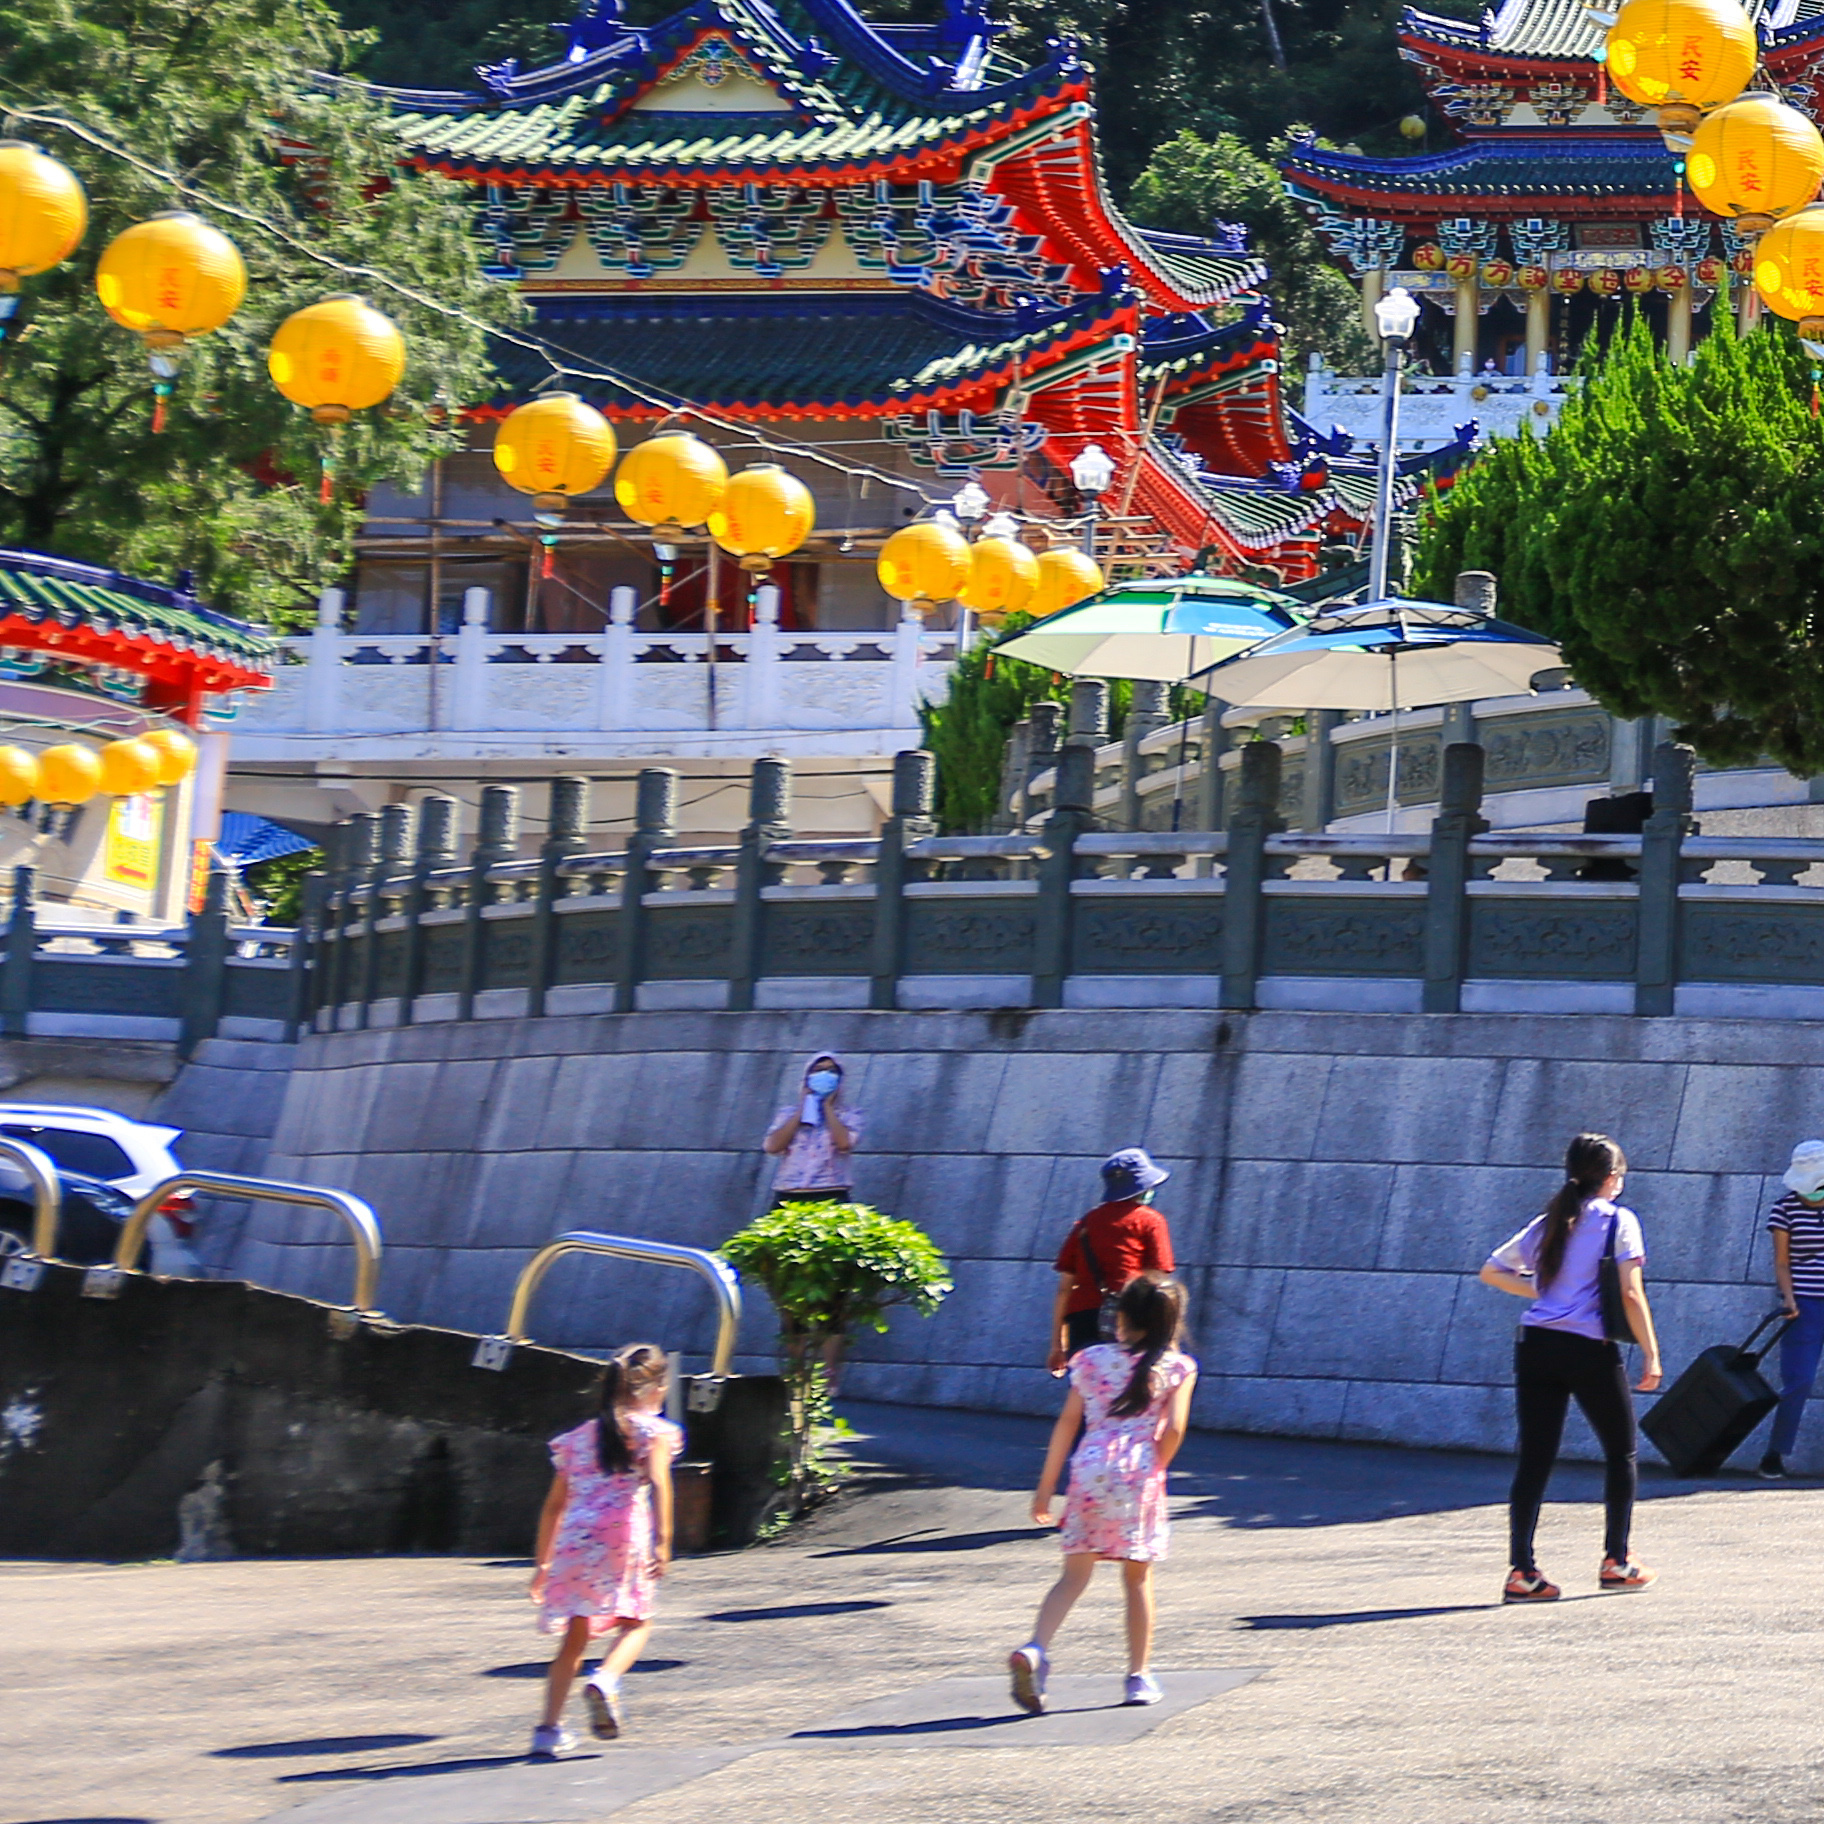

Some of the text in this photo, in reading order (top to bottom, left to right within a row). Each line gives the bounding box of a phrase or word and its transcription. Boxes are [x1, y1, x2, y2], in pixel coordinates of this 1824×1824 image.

[1679, 35, 1702, 82] 民安
[1737, 149, 1762, 193] 民安
[1802, 257, 1824, 298] 民安
